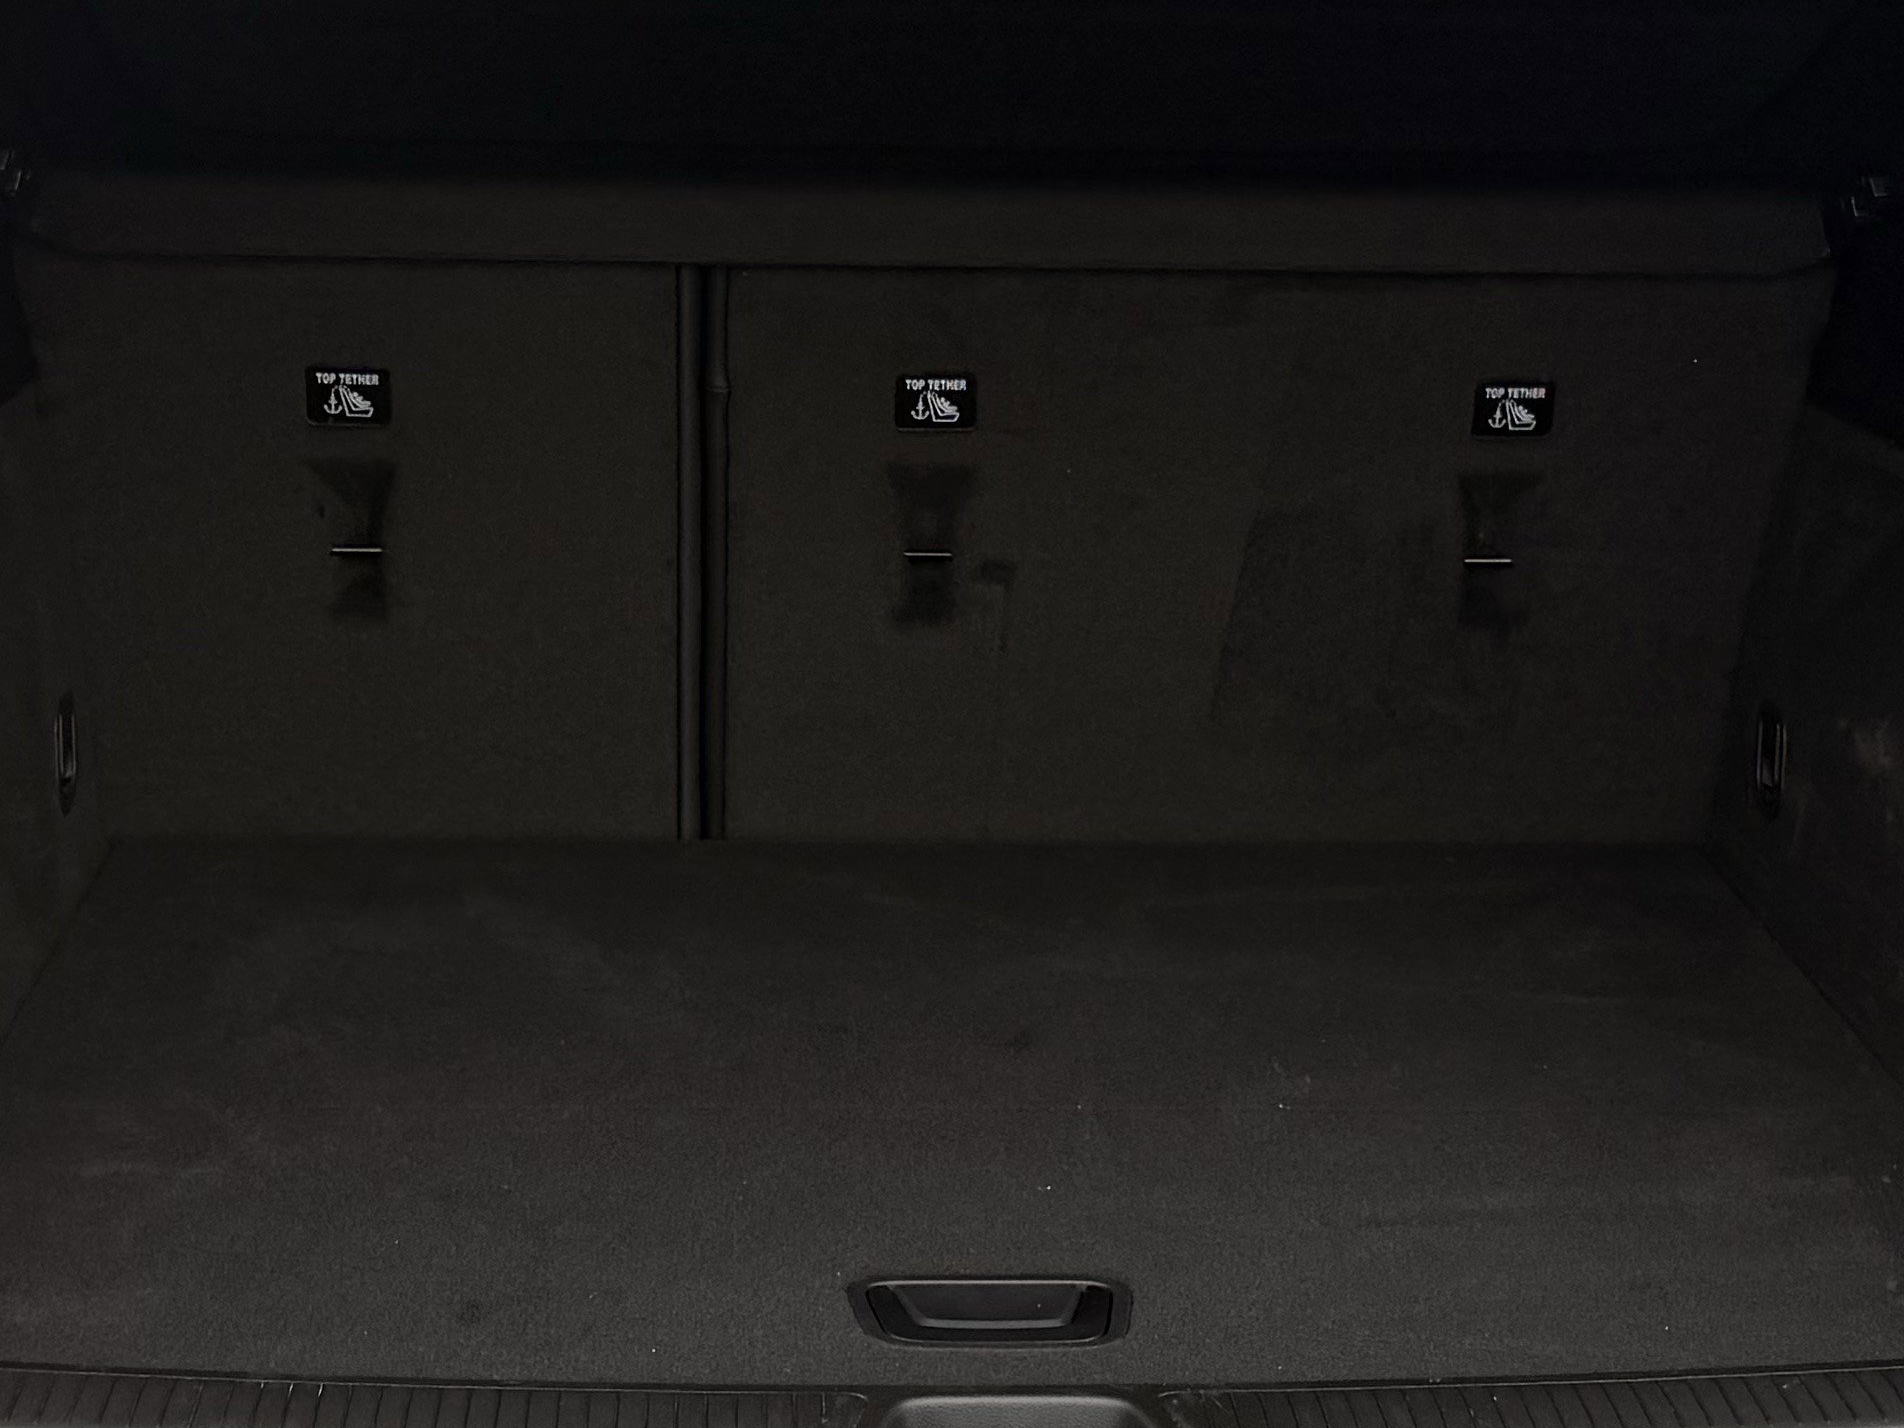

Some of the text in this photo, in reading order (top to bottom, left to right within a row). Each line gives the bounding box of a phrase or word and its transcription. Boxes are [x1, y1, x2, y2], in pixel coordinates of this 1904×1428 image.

[316, 372, 379, 386] TOP TETHER
[905, 379, 967, 391] TOP TETHER
[1485, 387, 1546, 399] TOP TETHER
